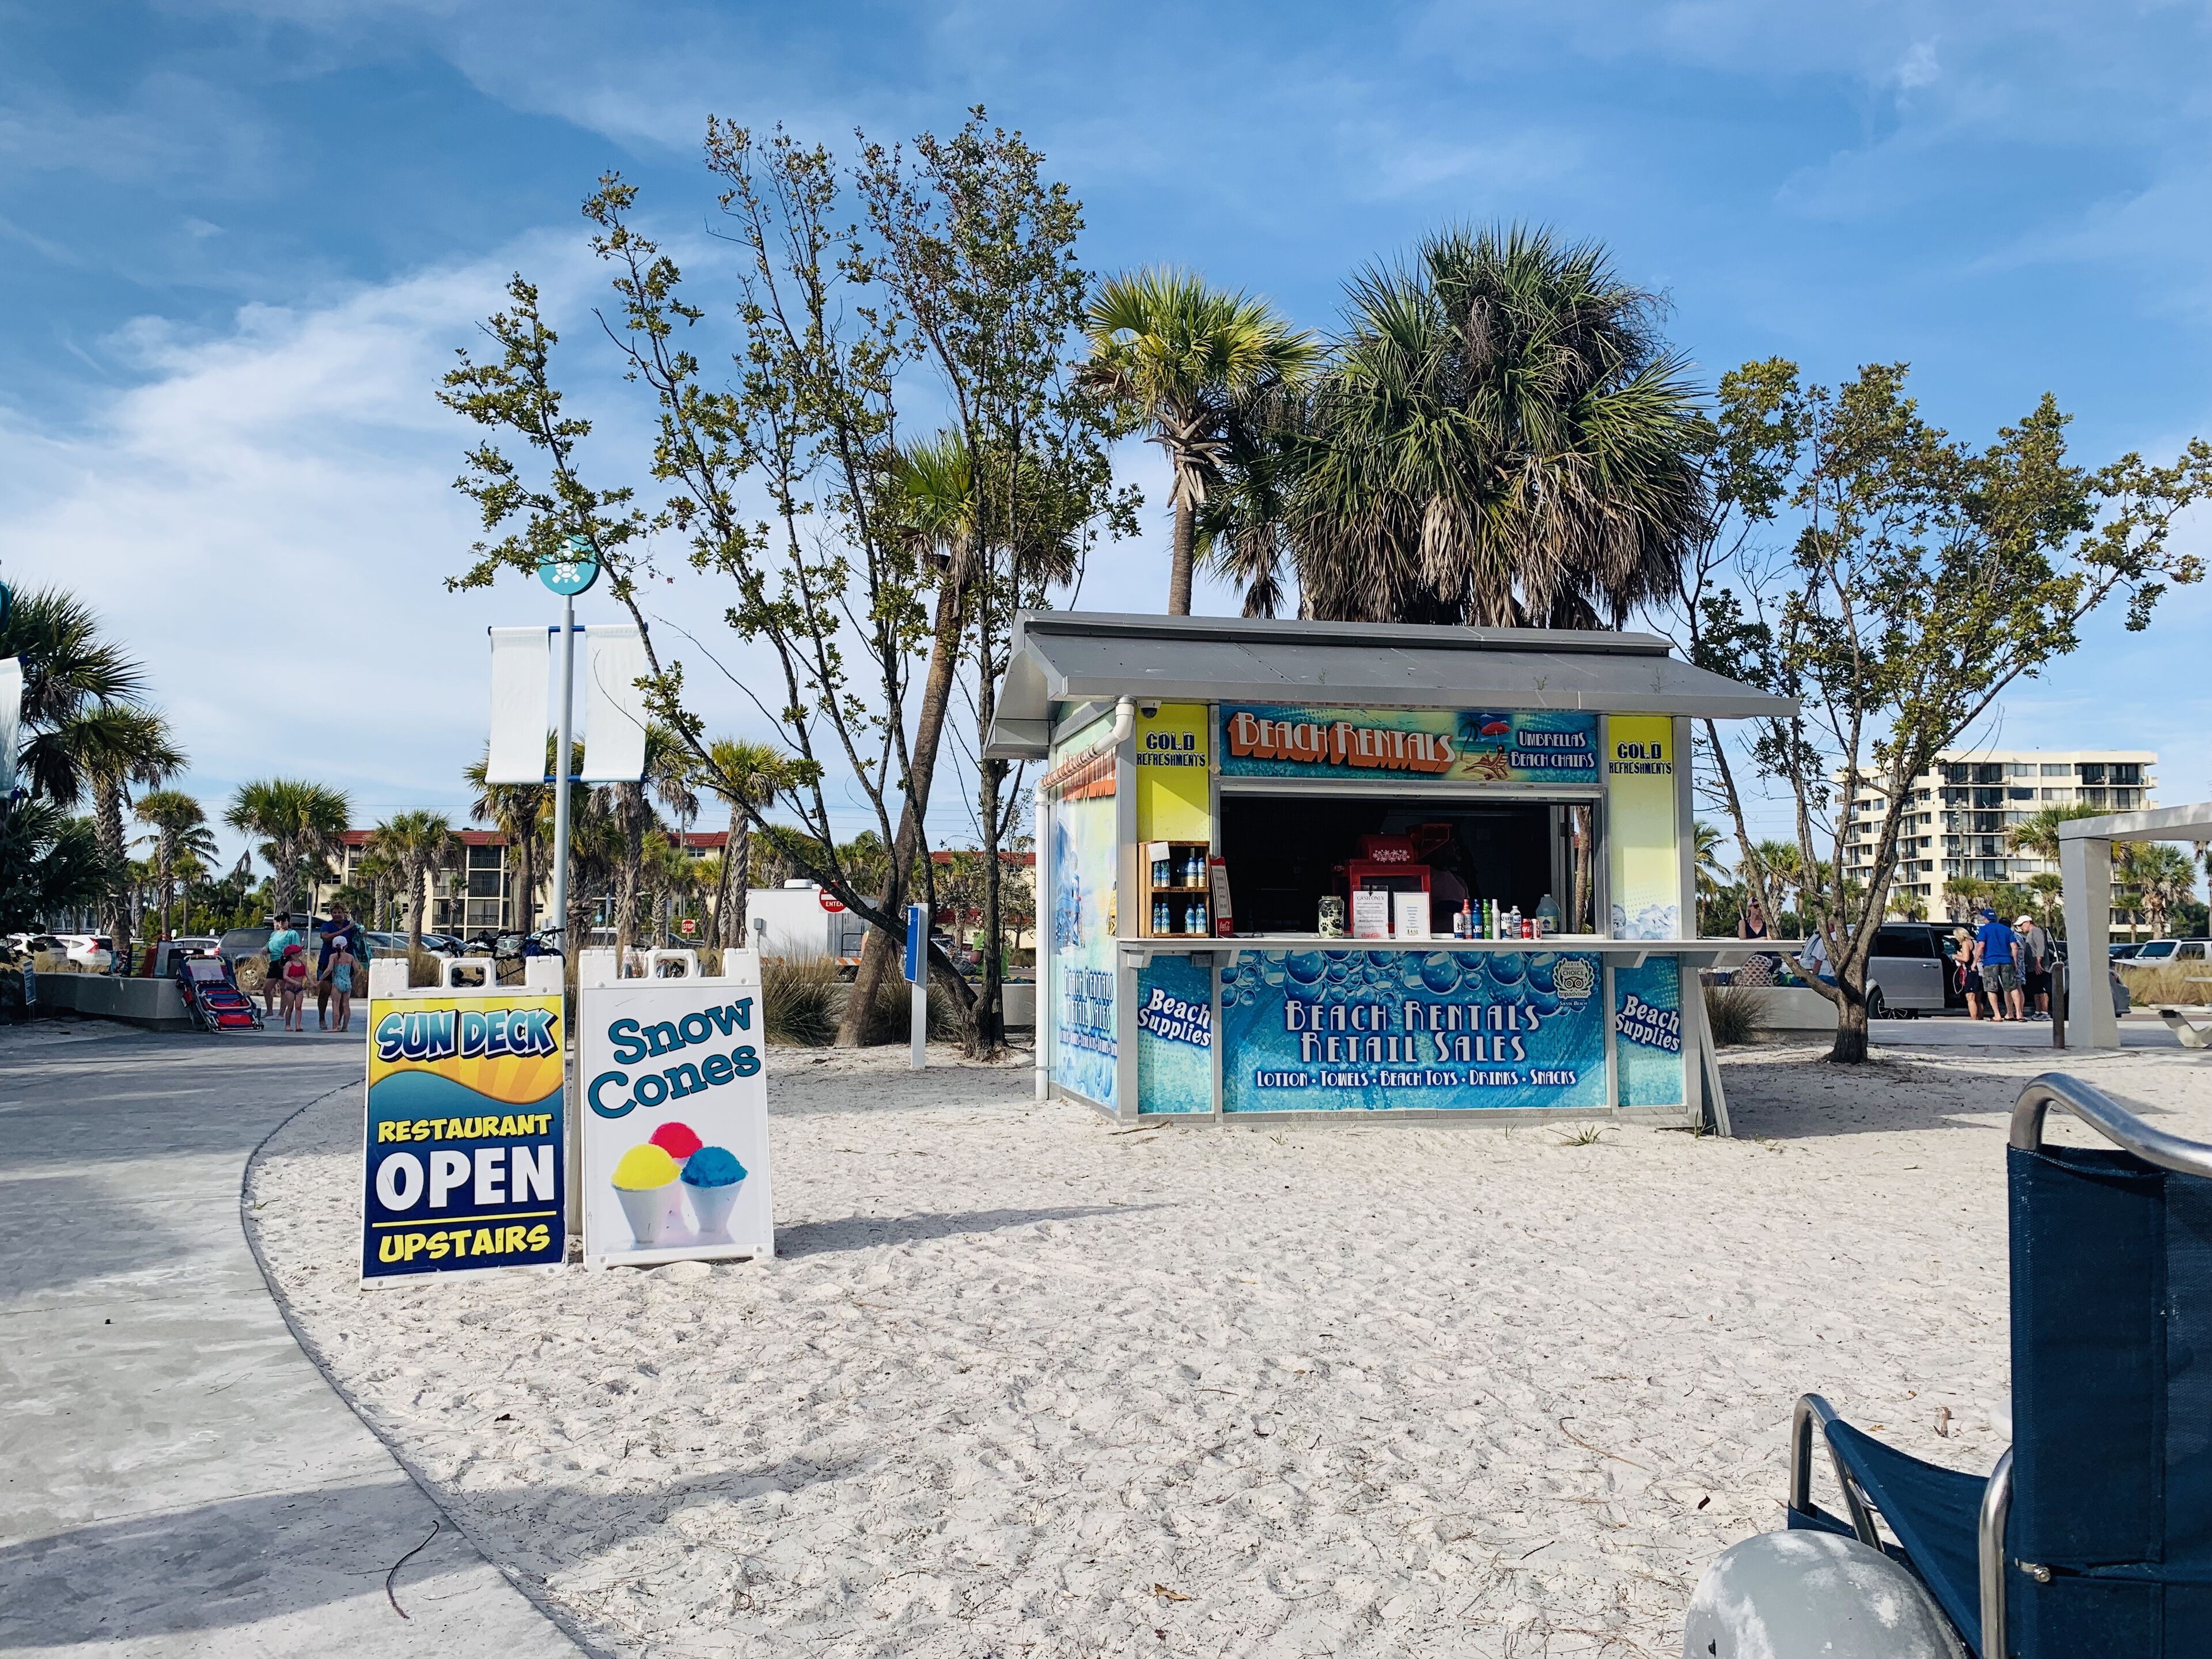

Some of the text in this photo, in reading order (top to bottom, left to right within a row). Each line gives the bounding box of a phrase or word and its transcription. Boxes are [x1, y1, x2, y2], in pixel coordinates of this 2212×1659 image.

[1146, 730, 1195, 750] COLD
[1232, 712, 1457, 768] BEACH RENTALS
[1519, 731, 1586, 747] UMBRELLAS
[1617, 740, 1662, 759] COLD
[1137, 751, 1206, 767] REFRESHMENTS
[1511, 751, 1595, 768] BEACH CHAIRS
[1608, 760, 1672, 774] REFRESHMENTS
[1065, 968, 1114, 1001] BEACH RENTALS
[1090, 999, 1111, 1031] SALES
[1147, 987, 1211, 1029] Beach
[1285, 1000, 1539, 1031] BEACH RENTALS
[1622, 995, 1680, 1035] Beach
[375, 1008, 558, 1062] SUN DECK
[608, 997, 753, 1065] Snow
[1137, 1008, 1211, 1047] Supplies
[1615, 1013, 1680, 1051] Supplies
[1301, 1032, 1525, 1062] RETAIL SALES
[588, 1046, 761, 1119] Cones
[1257, 1069, 1577, 1087] LOTION TOWELS BEACH TOYS DRINKS SNACKS
[378, 1113, 553, 1144] RESTAURANT
[376, 1145, 555, 1211] OPEN
[378, 1224, 551, 1263] UPSTAIRS
